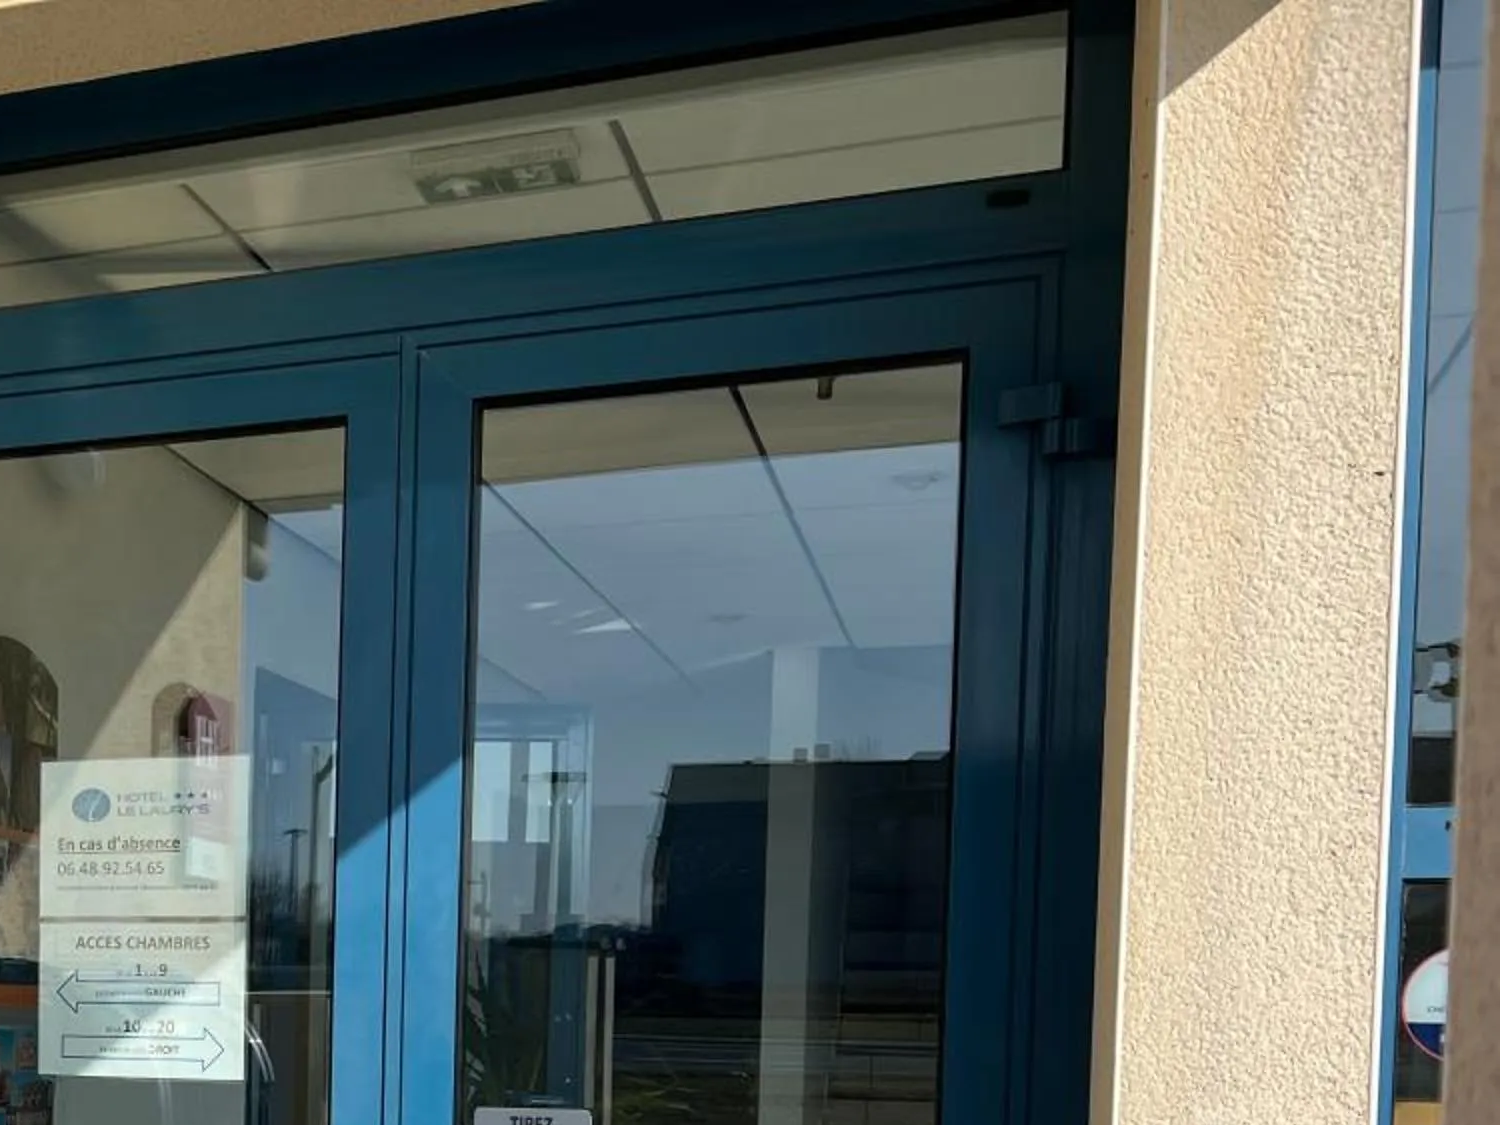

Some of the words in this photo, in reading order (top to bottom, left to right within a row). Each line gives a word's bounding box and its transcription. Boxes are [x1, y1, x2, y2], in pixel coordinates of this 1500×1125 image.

[58, 837, 75, 850] En
[79, 840, 102, 850] cas
[107, 836, 181, 850] d'absence
[75, 935, 122, 950] ACCES
[126, 936, 210, 950] CHAMBRES
